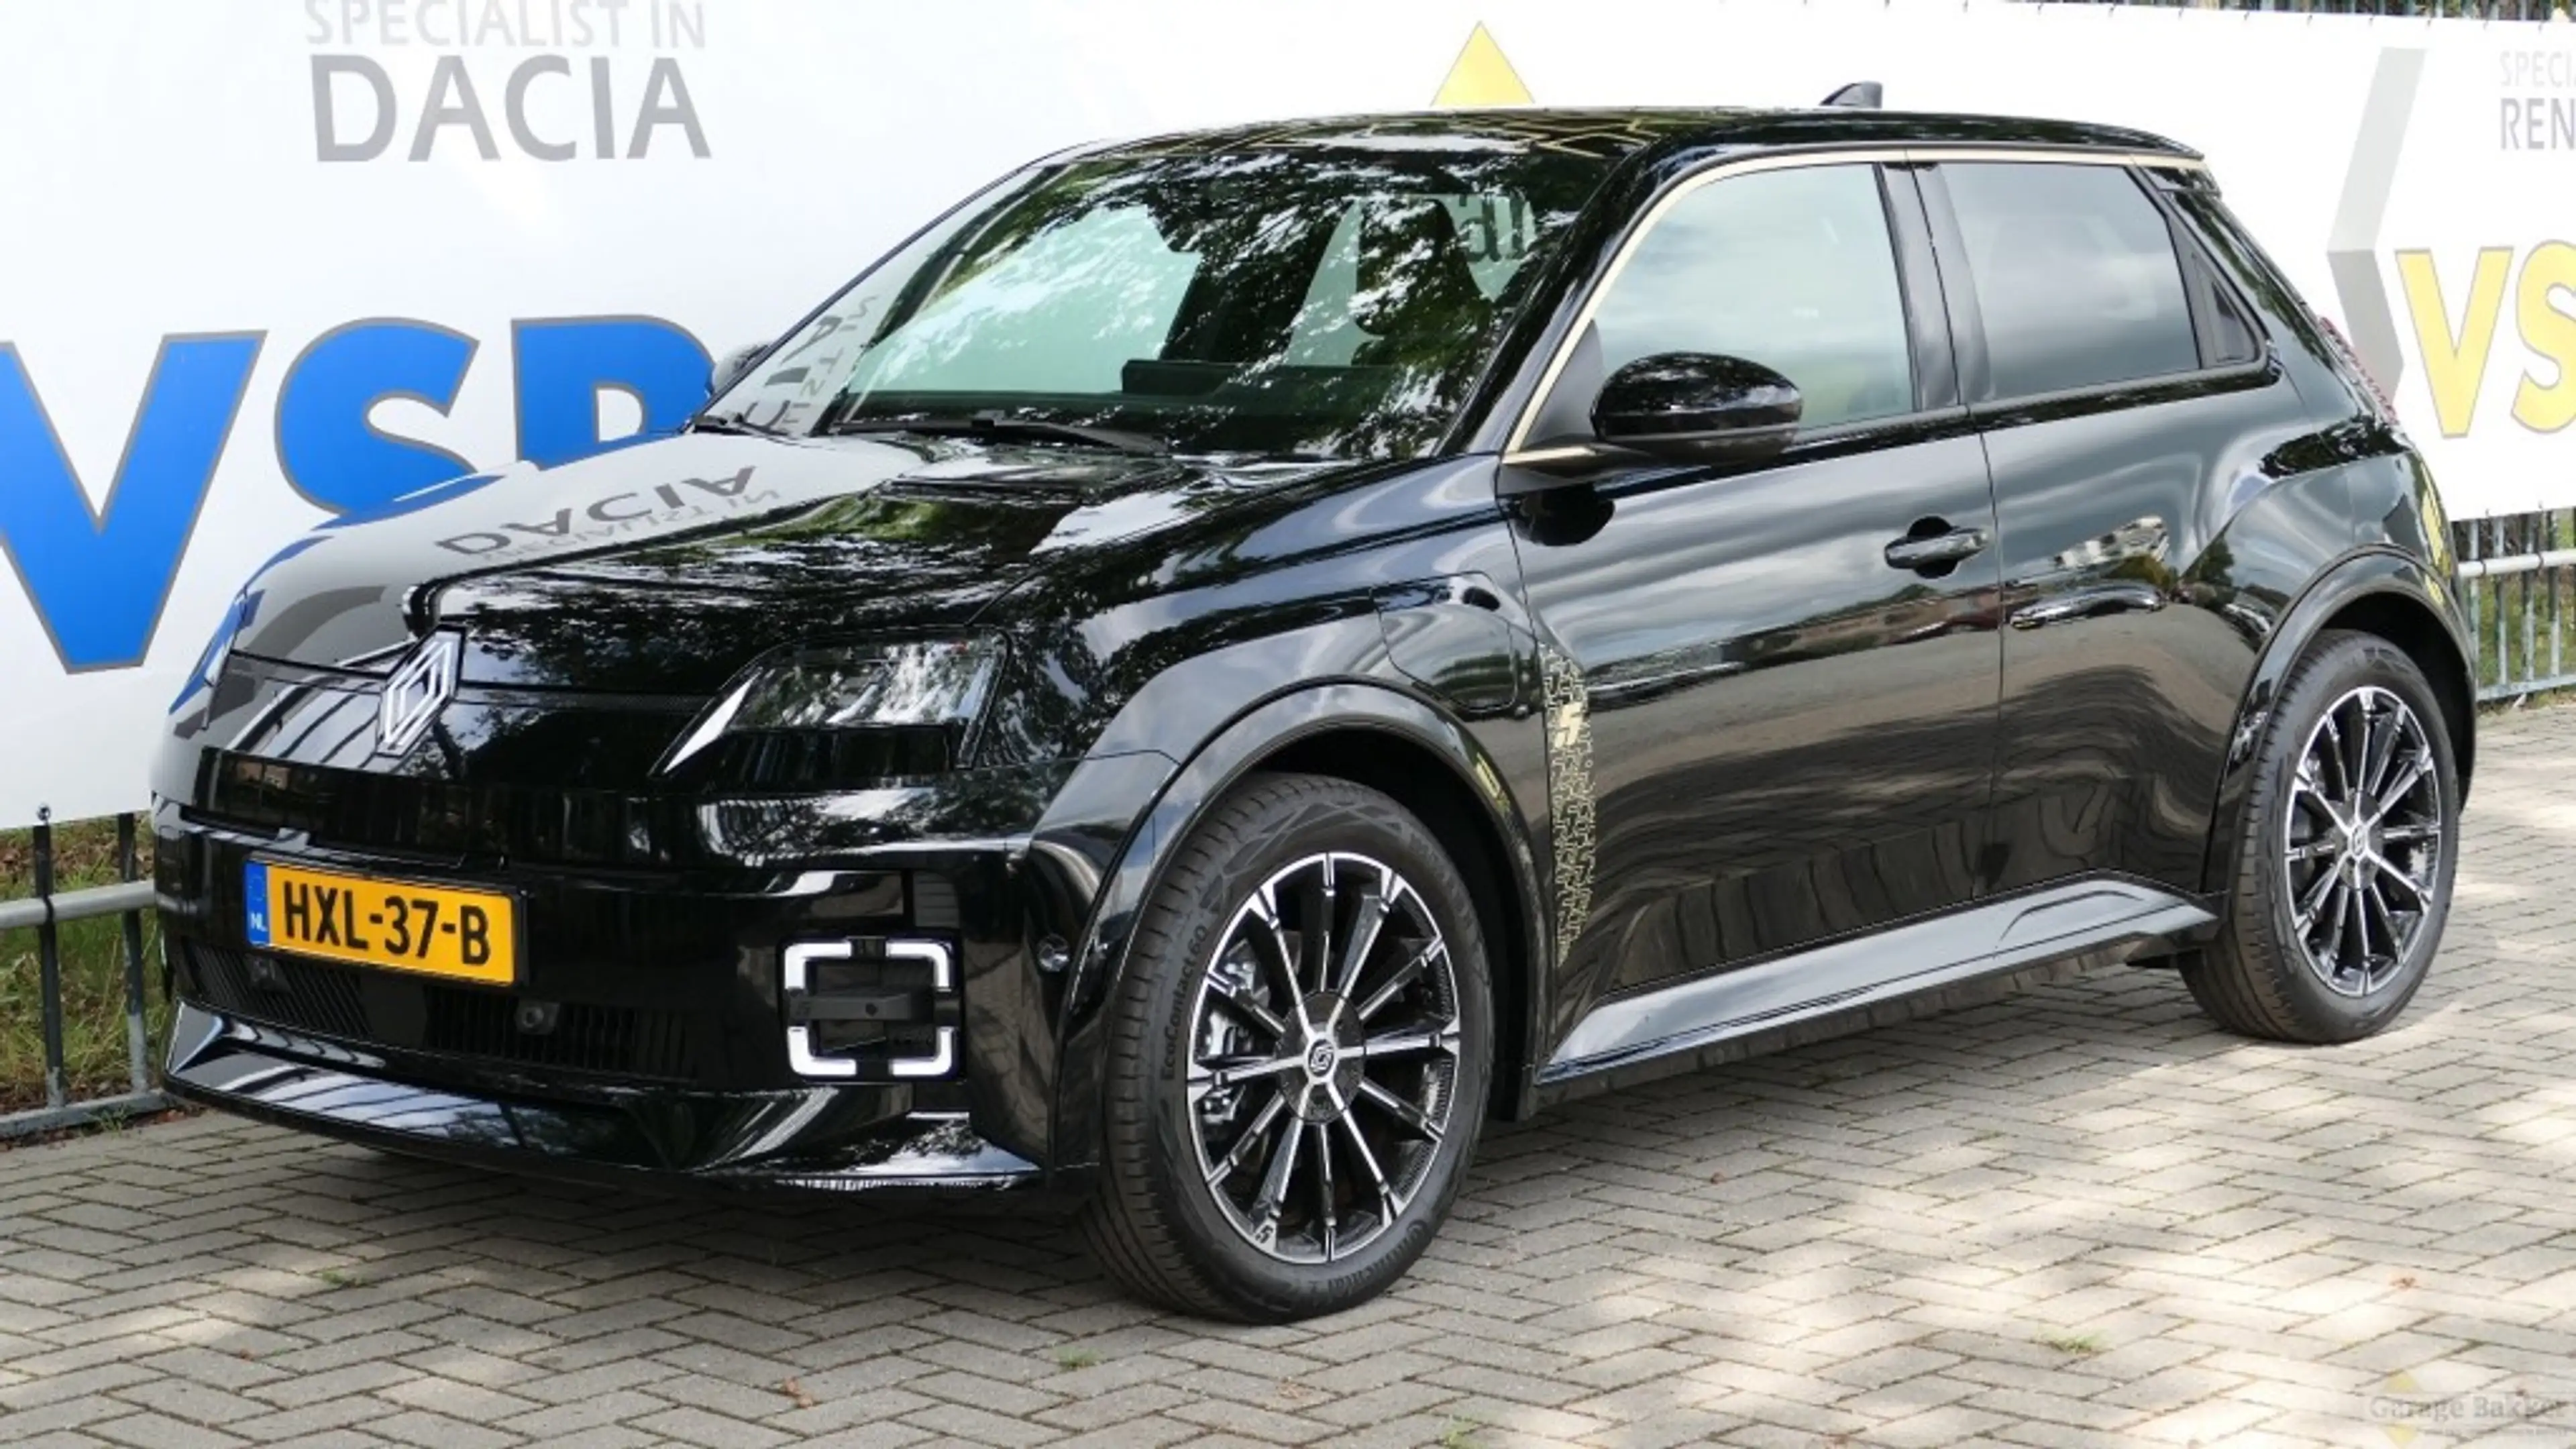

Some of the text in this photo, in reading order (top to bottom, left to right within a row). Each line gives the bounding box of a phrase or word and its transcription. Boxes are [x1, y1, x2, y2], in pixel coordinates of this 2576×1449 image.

[305, 0, 705, 48] SPECIALIST IN
[311, 55, 711, 162] DACIA
[2501, 98, 2576, 150] REN
[2394, 239, 2576, 439] VS
[283, 881, 491, 967] HXL-37-B
